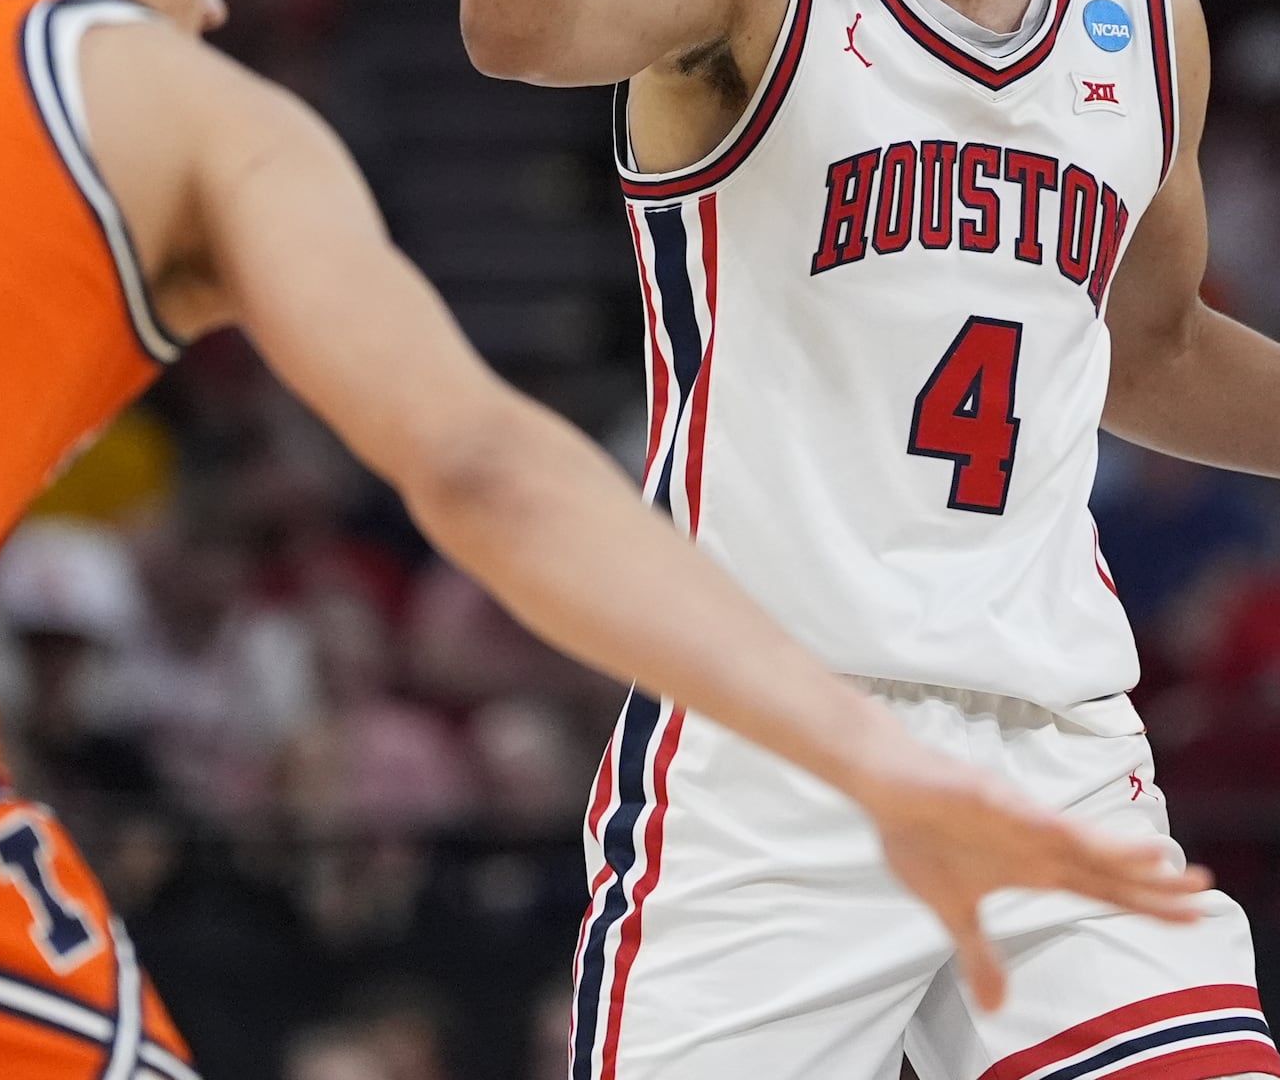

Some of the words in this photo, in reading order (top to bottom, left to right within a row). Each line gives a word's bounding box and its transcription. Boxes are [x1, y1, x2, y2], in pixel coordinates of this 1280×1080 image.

[1092, 22, 1130, 38] NCAA
[1082, 80, 1120, 104] XII
[810, 139, 1129, 319] HOUSTON
[907, 315, 1023, 516] 4
